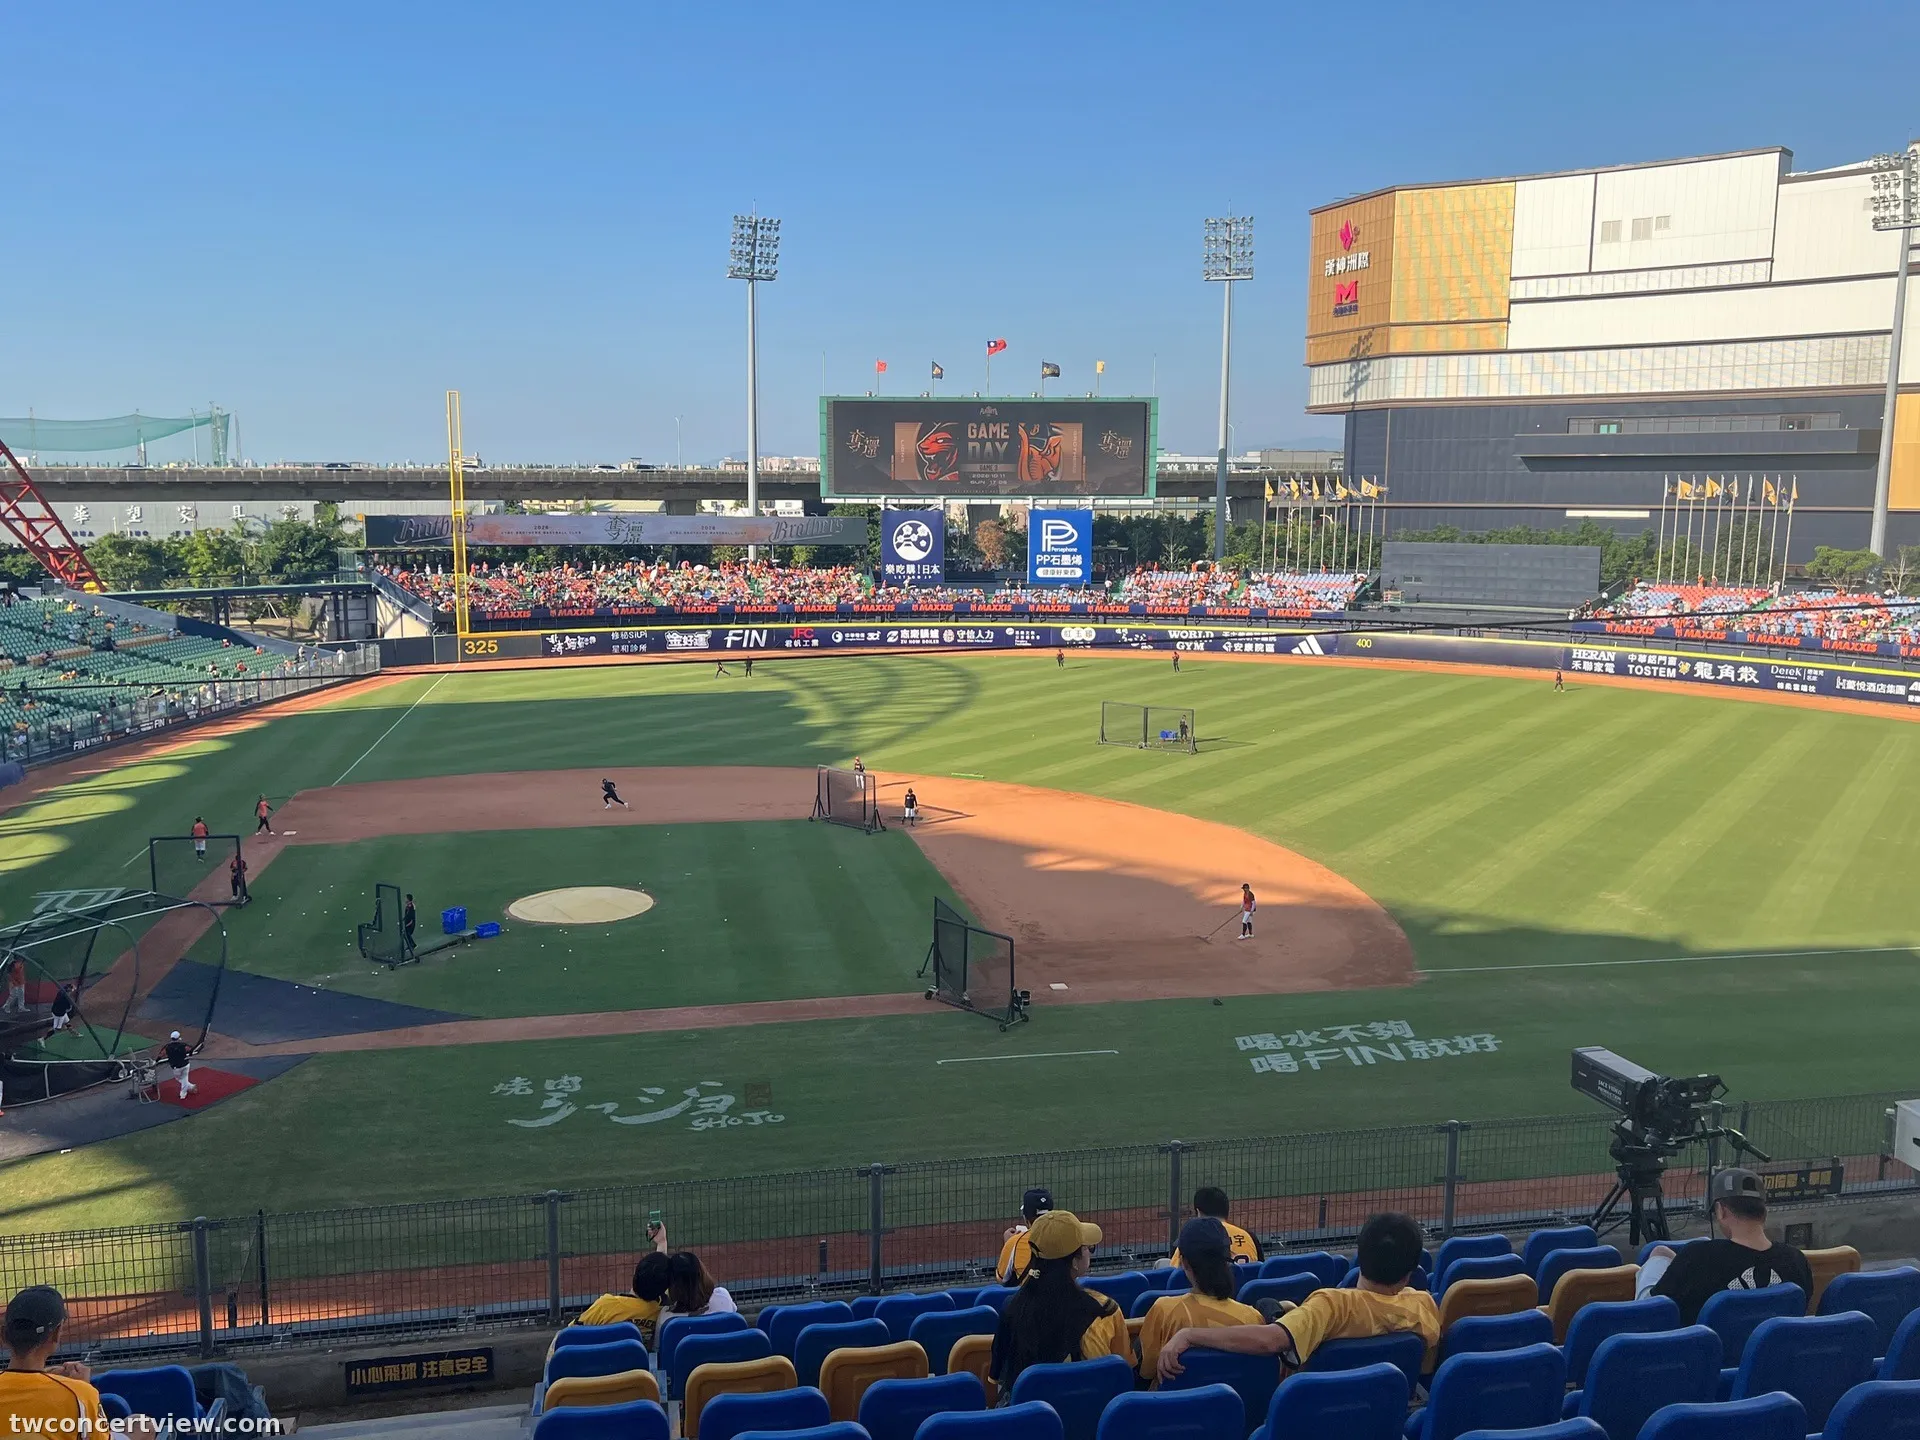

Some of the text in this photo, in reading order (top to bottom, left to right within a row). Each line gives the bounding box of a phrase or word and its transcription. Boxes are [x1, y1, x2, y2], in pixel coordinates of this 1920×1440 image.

[1325, 252, 1370, 277] 漢神洲際
[967, 422, 1010, 439] GAME
[967, 441, 1009, 461] DAY
[768, 517, 844, 543] Brothers
[1036, 554, 1083, 566] PP石墨烯
[620, 607, 657, 615] MAXXIS
[682, 605, 718, 614] MAXXIS
[742, 604, 778, 613] MAXXIS
[800, 604, 837, 612] MAXXIS
[861, 604, 896, 612] MAXXIS
[919, 603, 954, 611] MAXXIS
[978, 604, 1012, 612] MAXXIS
[1036, 604, 1071, 612] MAXXIS
[1095, 605, 1129, 613] MAXXIS
[1155, 606, 1189, 614] MAXXIS
[1214, 606, 1250, 616] MAXXIS
[494, 610, 531, 619] MAXXIS
[557, 609, 595, 618] MAXXIS
[1274, 608, 1311, 618] MAXXIS
[957, 630, 994, 639] 守信人力
[1167, 630, 1215, 639] WORLD
[1615, 624, 1655, 636] MAXXIS
[1684, 629, 1727, 641] MAXXIS
[724, 629, 768, 648] FIN
[1356, 638, 1372, 648] 400
[1756, 635, 1800, 646] MAXXIS
[464, 640, 498, 654] 325
[1176, 641, 1204, 651] GYM
[1832, 639, 1877, 653] MAXXIS
[1572, 648, 1616, 662] HERAN
[1571, 660, 1615, 674] 禾聯家電
[1627, 664, 1677, 678] TOSTEM
[1693, 661, 1760, 685] 龍角散
[73, 739, 85, 751] FIN
[1235, 1020, 1416, 1052] 喝水不夠
[351, 1356, 488, 1385] 小心飛球 注意安全
